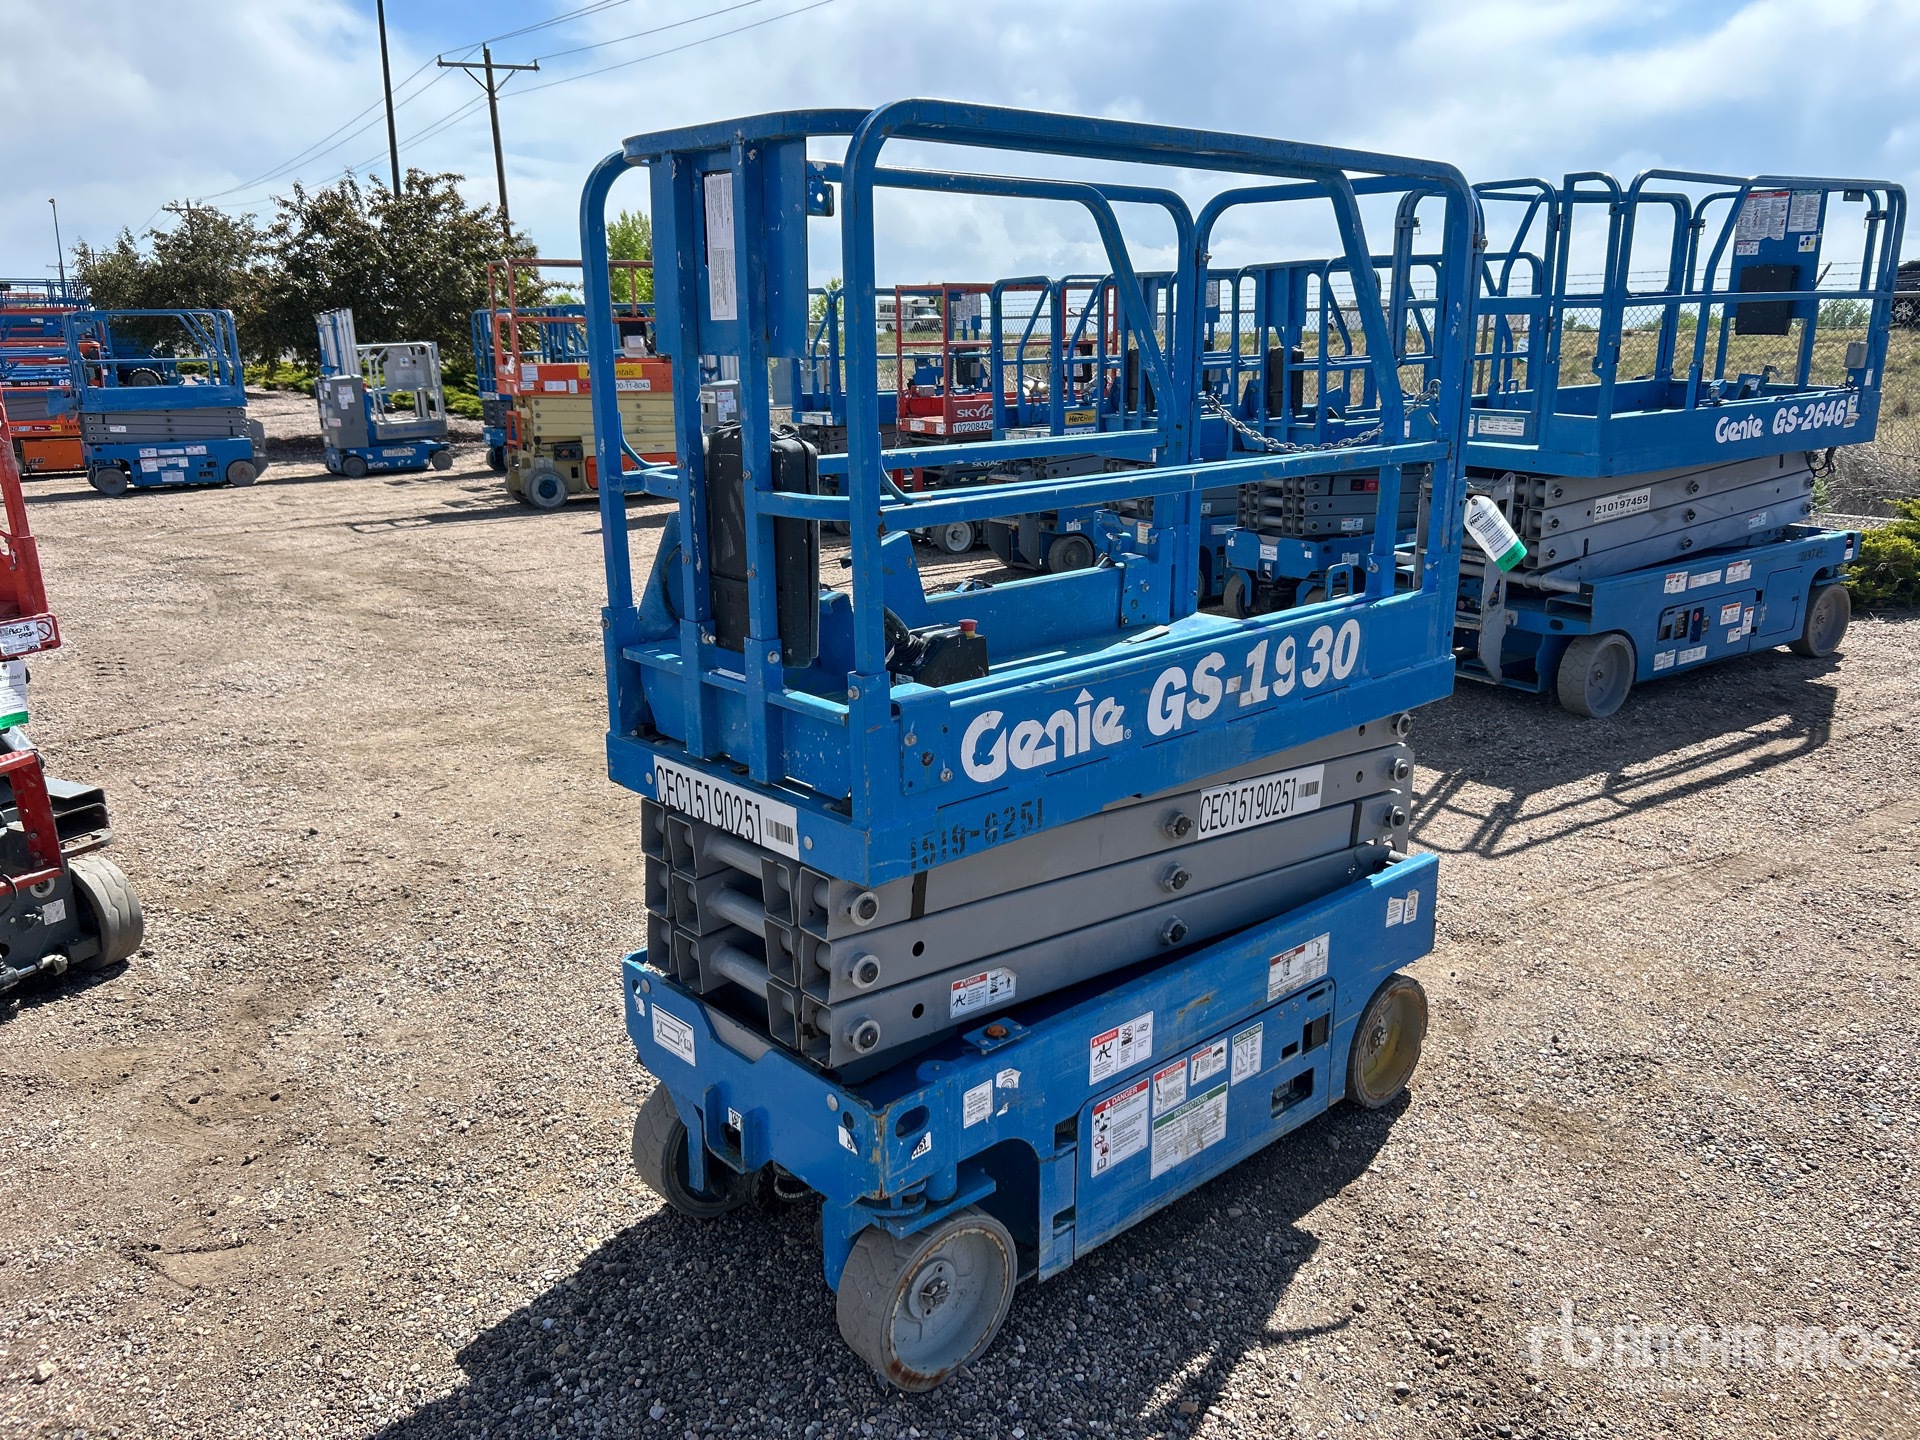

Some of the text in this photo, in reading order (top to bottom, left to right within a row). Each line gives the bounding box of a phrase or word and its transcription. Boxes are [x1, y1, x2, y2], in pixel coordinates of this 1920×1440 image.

[953, 421, 990, 434] 10220842
[1715, 399, 1846, 444] Genie GS-2646
[27, 457, 45, 465] JLG
[1595, 494, 1649, 515] 210197459
[960, 618, 1361, 783] Genie GS-1930
[655, 764, 763, 846] CEC15190251
[1200, 776, 1297, 833] CEC15190251
[1098, 1031, 1118, 1043] DANGER
[1111, 1086, 1138, 1106] DANGER
[1173, 1093, 1209, 1119] INSTRUCTIONS
